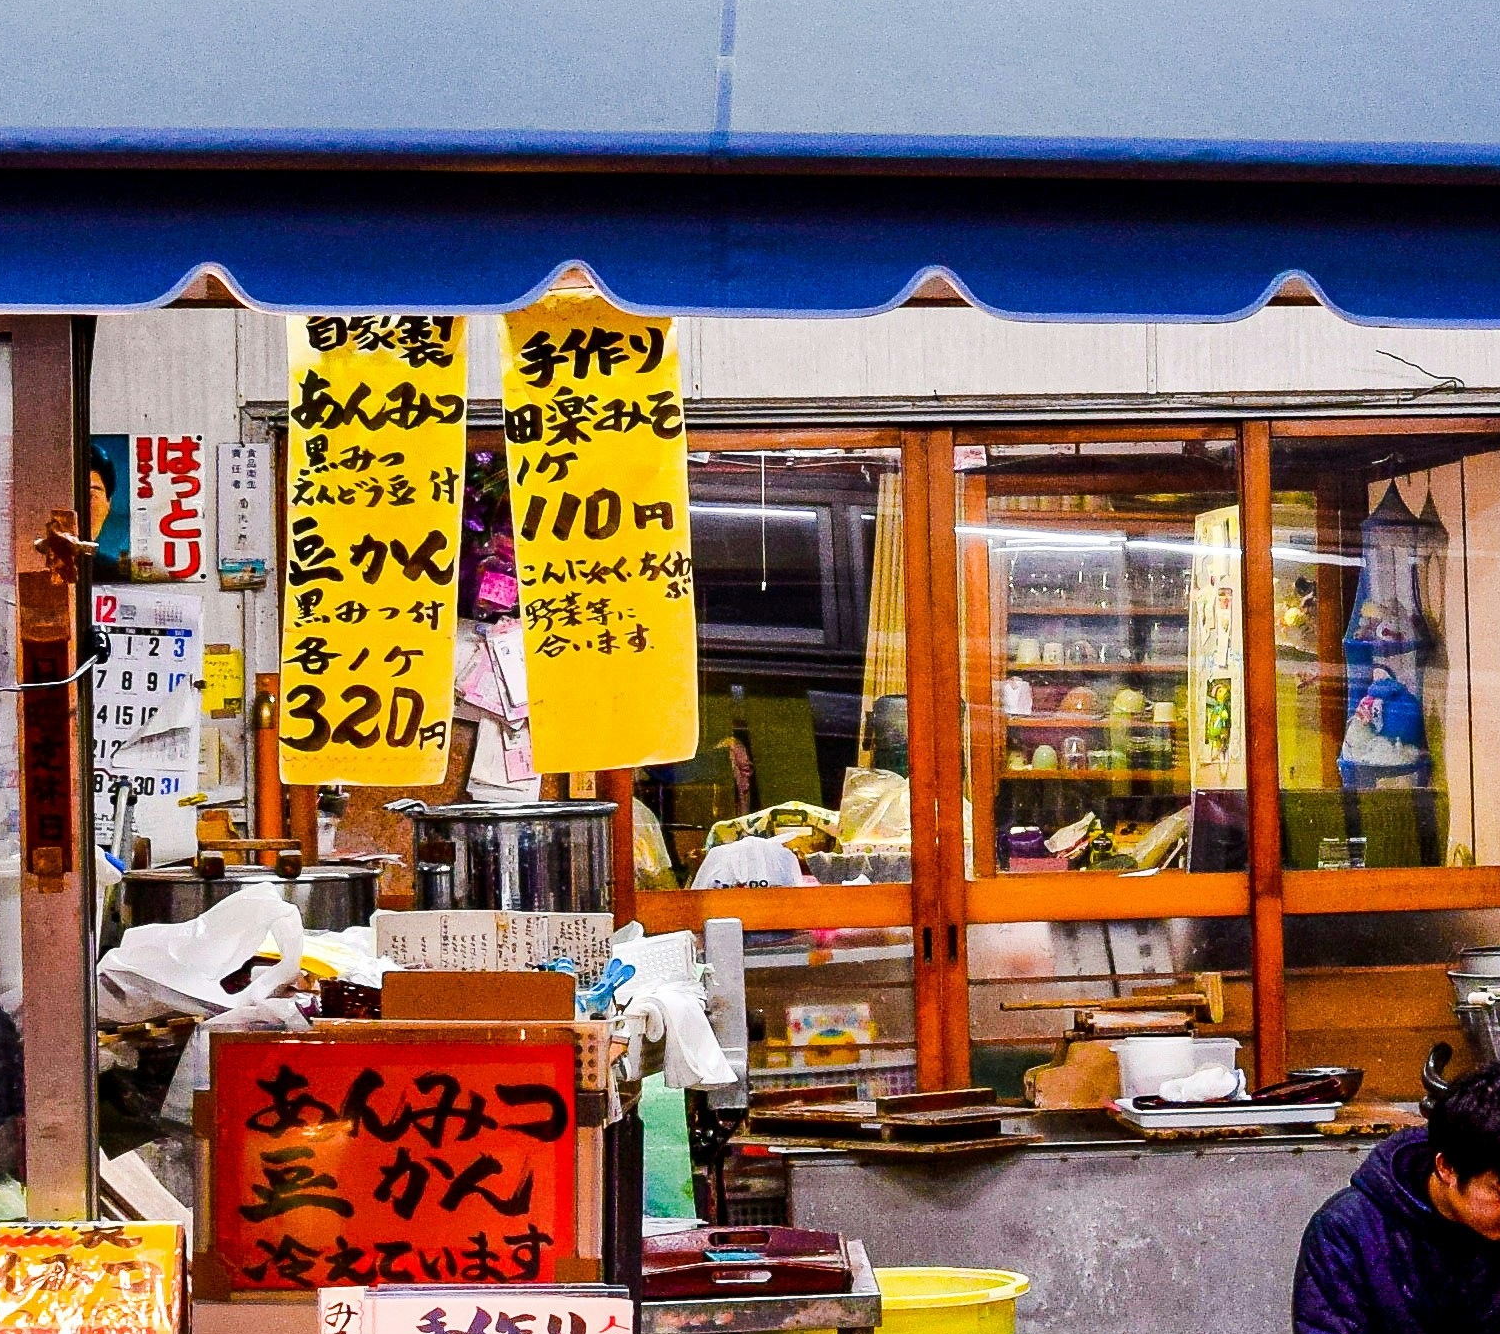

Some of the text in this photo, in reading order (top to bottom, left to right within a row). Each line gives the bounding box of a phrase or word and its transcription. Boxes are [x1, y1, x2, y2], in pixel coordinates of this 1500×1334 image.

[520, 326, 666, 388] 手作り
[290, 378, 464, 432] あんみつ
[504, 389, 682, 447] 田楽みそ
[158, 436, 201, 579] はっとり
[520, 488, 675, 542] 110円
[96, 595, 117, 623] 12
[150, 637, 160, 656] 2
[174, 639, 184, 657] 3
[122, 672, 132, 689] 8
[147, 673, 158, 691] 9
[116, 706, 133, 725] 15
[281, 685, 446, 753] 320円
[247, 1065, 567, 1145] あんみつ
[243, 1226, 555, 1288] 冷えています
